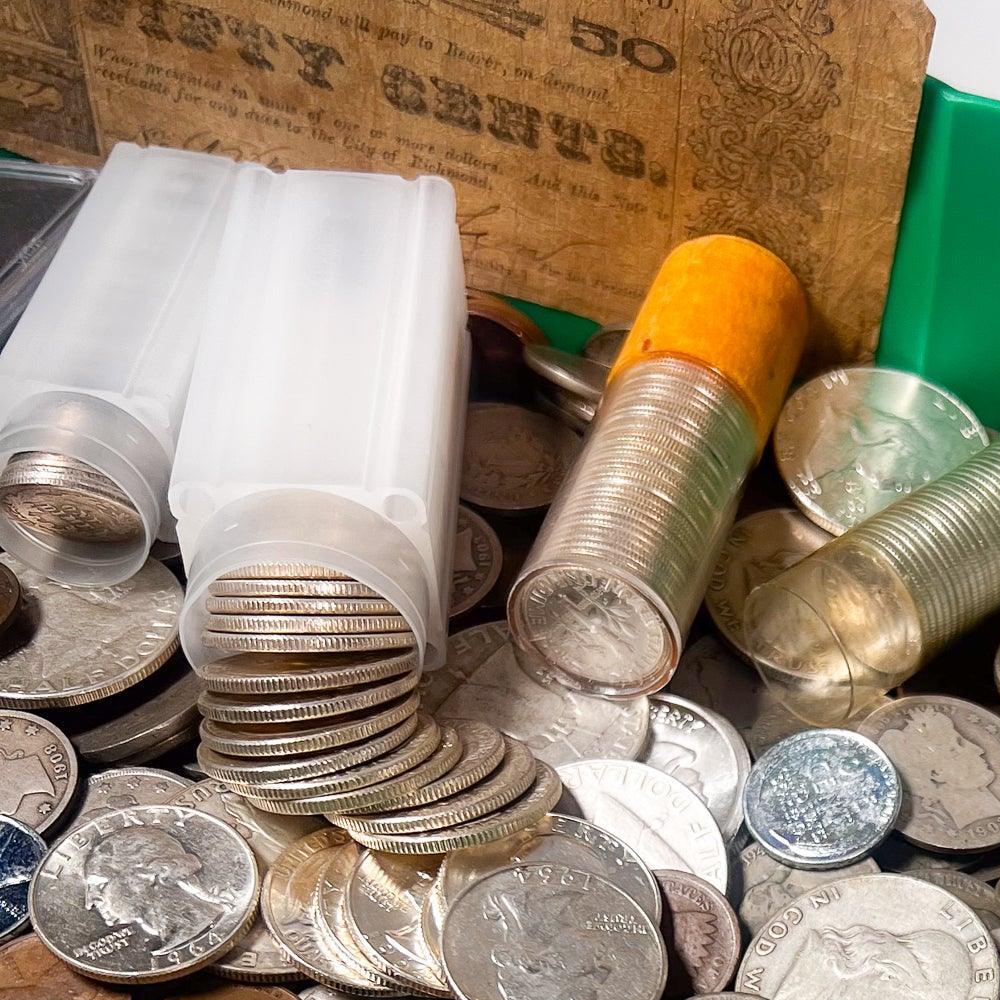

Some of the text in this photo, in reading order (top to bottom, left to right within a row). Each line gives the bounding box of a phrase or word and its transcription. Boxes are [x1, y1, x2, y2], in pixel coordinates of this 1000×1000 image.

[418, 35, 434, 51] to
[570, 15, 677, 74] 50
[41, 807, 198, 881] LIBERTY
[810, 886, 842, 910] IN
[755, 907, 805, 957] GOD
